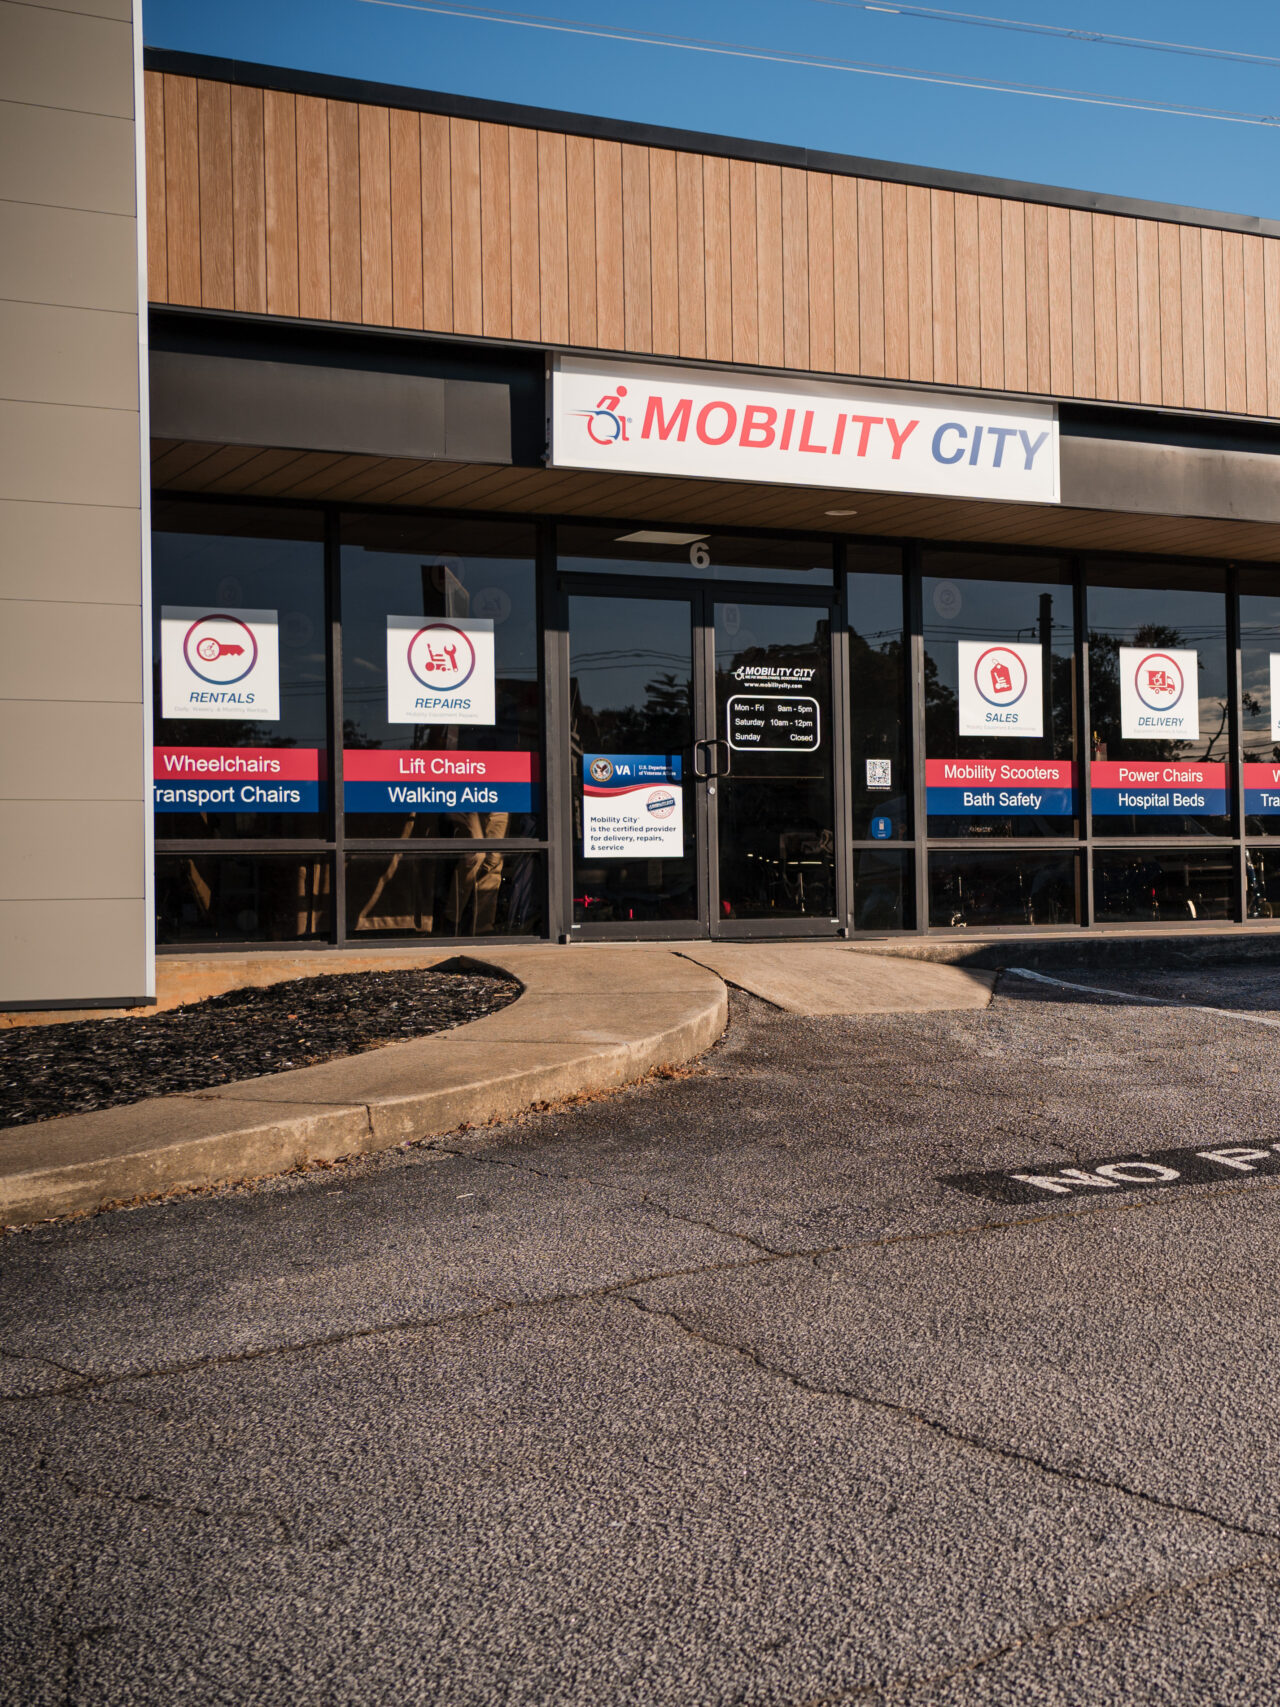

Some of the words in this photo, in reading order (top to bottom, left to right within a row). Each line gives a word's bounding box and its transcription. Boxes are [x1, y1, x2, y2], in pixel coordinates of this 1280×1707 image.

[640, 395, 921, 460] MOBILITY
[931, 422, 1050, 470] CITY
[689, 542, 710, 569] 6
[745, 667, 792, 676] MOBILITY
[793, 668, 816, 677] CITY
[189, 691, 256, 704] RENTALS
[415, 697, 471, 709] REPAIRS
[734, 703, 749, 711] Mon
[755, 704, 765, 712] Fri
[777, 704, 792, 713] 9am
[797, 705, 813, 714] 5pm
[735, 718, 765, 727] Saturday
[795, 719, 813, 728] 12pm
[985, 712, 1019, 723] SALES
[1137, 717, 1184, 727] DELIVERY
[735, 733, 761, 742] Sunday
[790, 733, 813, 741] Closed
[163, 754, 281, 773] Wheelchairs
[399, 758, 426, 774] Lift
[430, 758, 486, 775] Chairs
[615, 765, 631, 775] VA
[944, 764, 997, 782] Mobility
[1000, 765, 1060, 780] Scooters
[1119, 768, 1158, 782] Power
[1162, 768, 1204, 783] Chairs
[153, 785, 235, 806] ransport
[240, 785, 301, 803] Chairs
[387, 786, 457, 807] Walking
[460, 787, 499, 804] Aids
[963, 791, 995, 806] Bath
[999, 792, 1042, 810] Safety
[1118, 793, 1170, 810] Hospital
[1173, 793, 1205, 807] Beds
[590, 816, 621, 824] Mobility
[622, 816, 638, 824] City
[1009, 1160, 1181, 1194] NO
